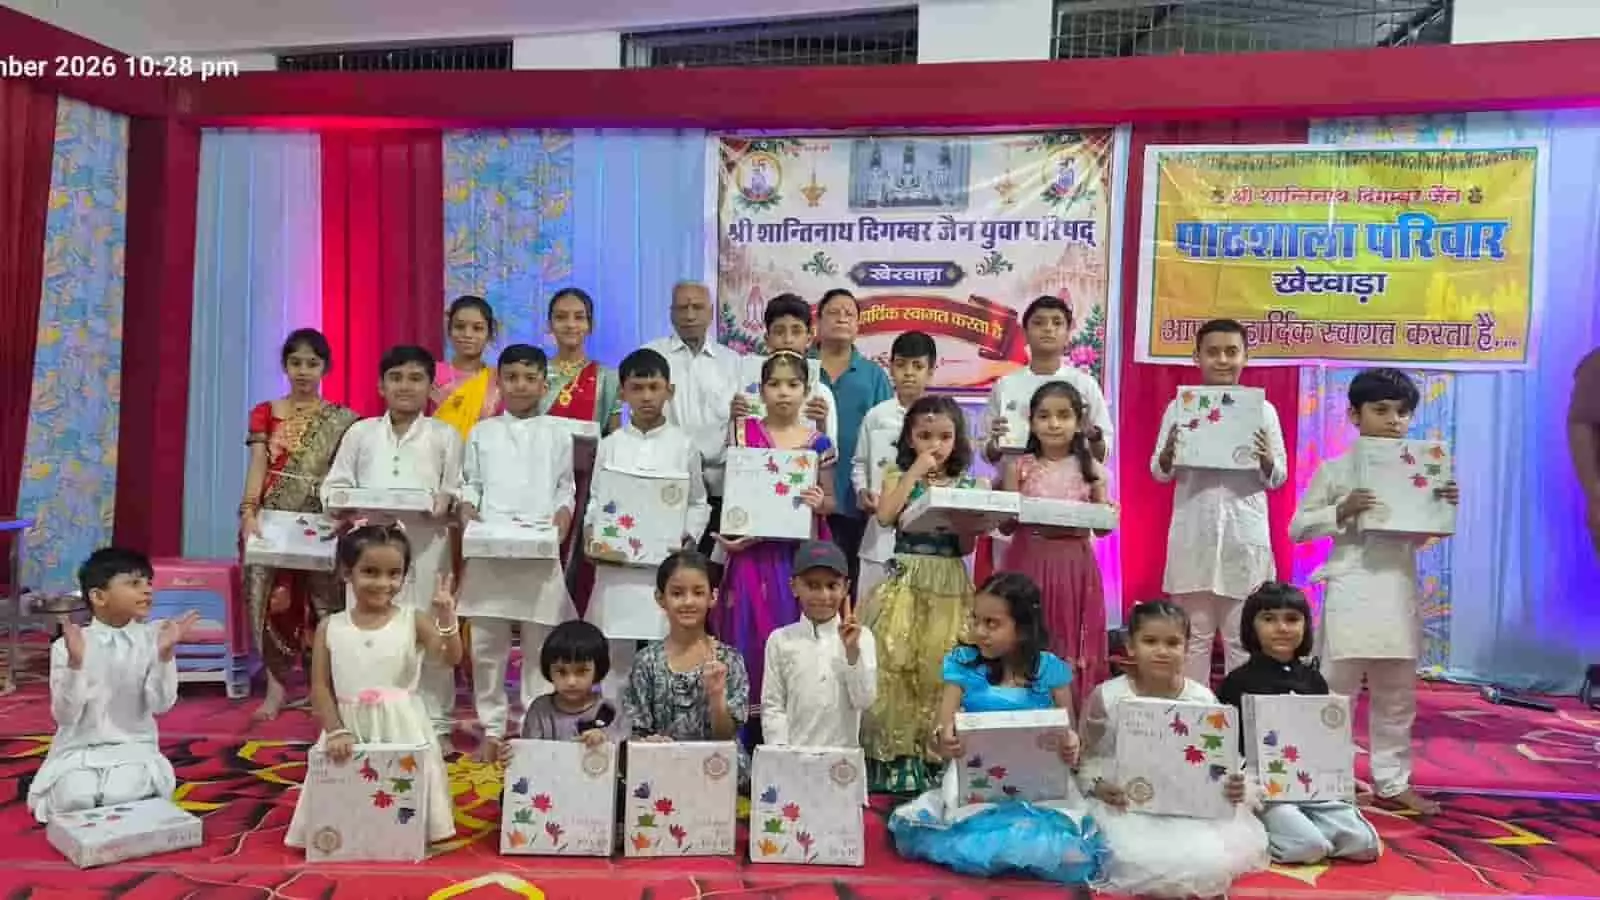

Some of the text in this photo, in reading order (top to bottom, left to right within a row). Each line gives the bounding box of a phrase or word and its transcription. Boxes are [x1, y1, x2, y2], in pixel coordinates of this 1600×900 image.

[1232, 185, 1253, 205] श्री
[728, 218, 753, 243] श्री
[757, 217, 855, 243] शान्तिनाथ
[858, 216, 931, 243] दिगम्बर
[938, 215, 977, 241] जैन
[981, 220, 1022, 250] युवा
[1175, 212, 1510, 260] पाठशाला परिवार
[1273, 266, 1387, 304] खेरवाड़ा
[1320, 321, 1396, 345] स्वागत
[1406, 322, 1472, 346] करता
